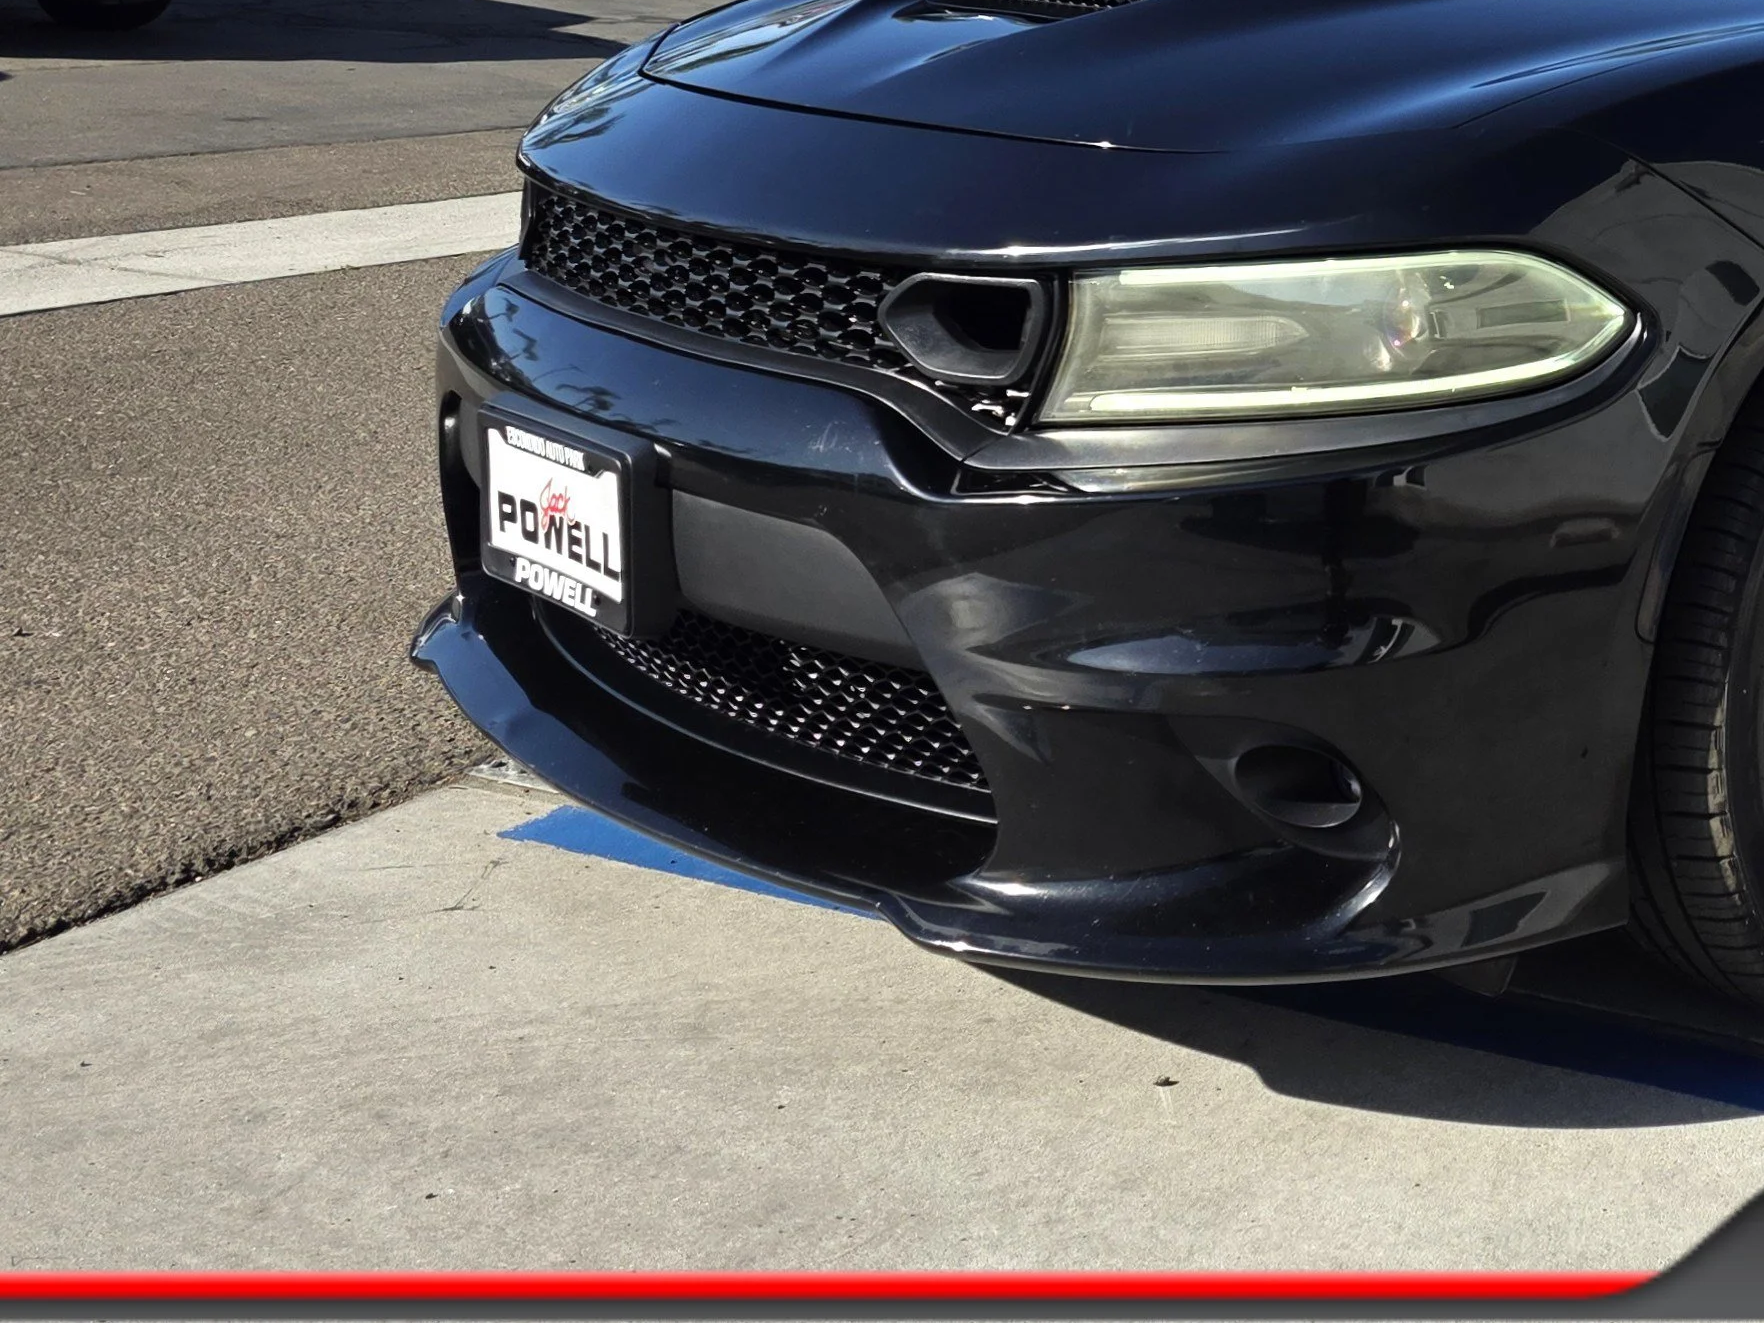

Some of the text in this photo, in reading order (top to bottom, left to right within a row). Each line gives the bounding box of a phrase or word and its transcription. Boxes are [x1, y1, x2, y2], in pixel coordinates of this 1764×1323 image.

[539, 477, 576, 531] Jack
[497, 490, 622, 583] POWELL
[515, 556, 597, 618] POWELL
